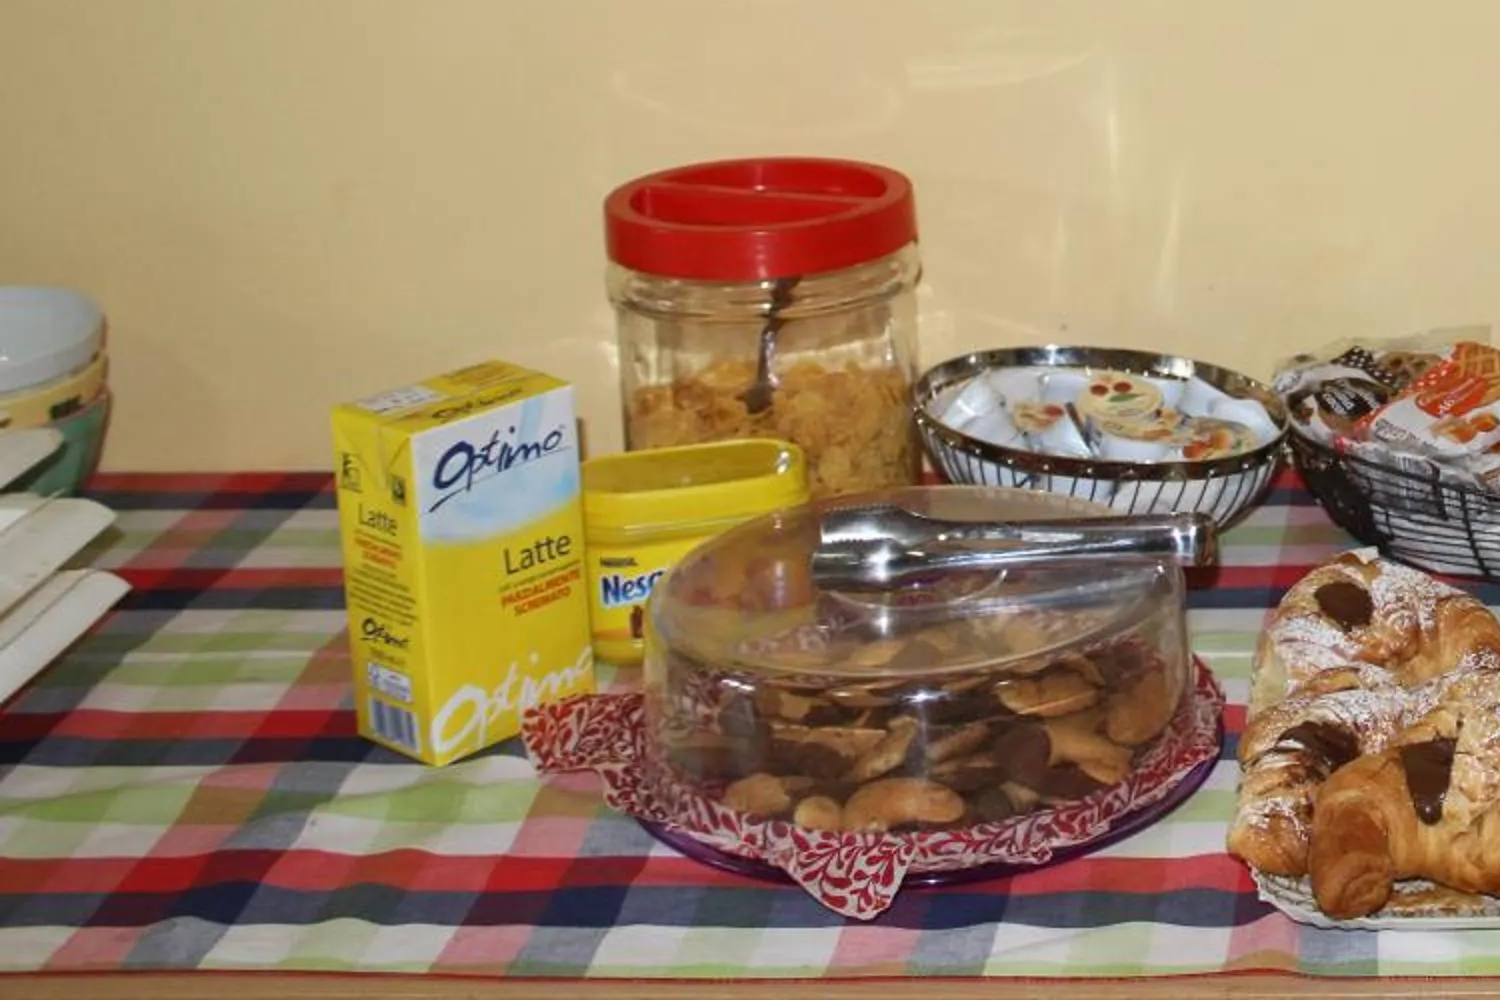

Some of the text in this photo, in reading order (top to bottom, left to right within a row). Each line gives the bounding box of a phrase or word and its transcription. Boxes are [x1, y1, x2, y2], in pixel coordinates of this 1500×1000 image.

[432, 425, 564, 492] Optimo
[357, 502, 398, 537] Latte
[503, 535, 572, 575] Latte
